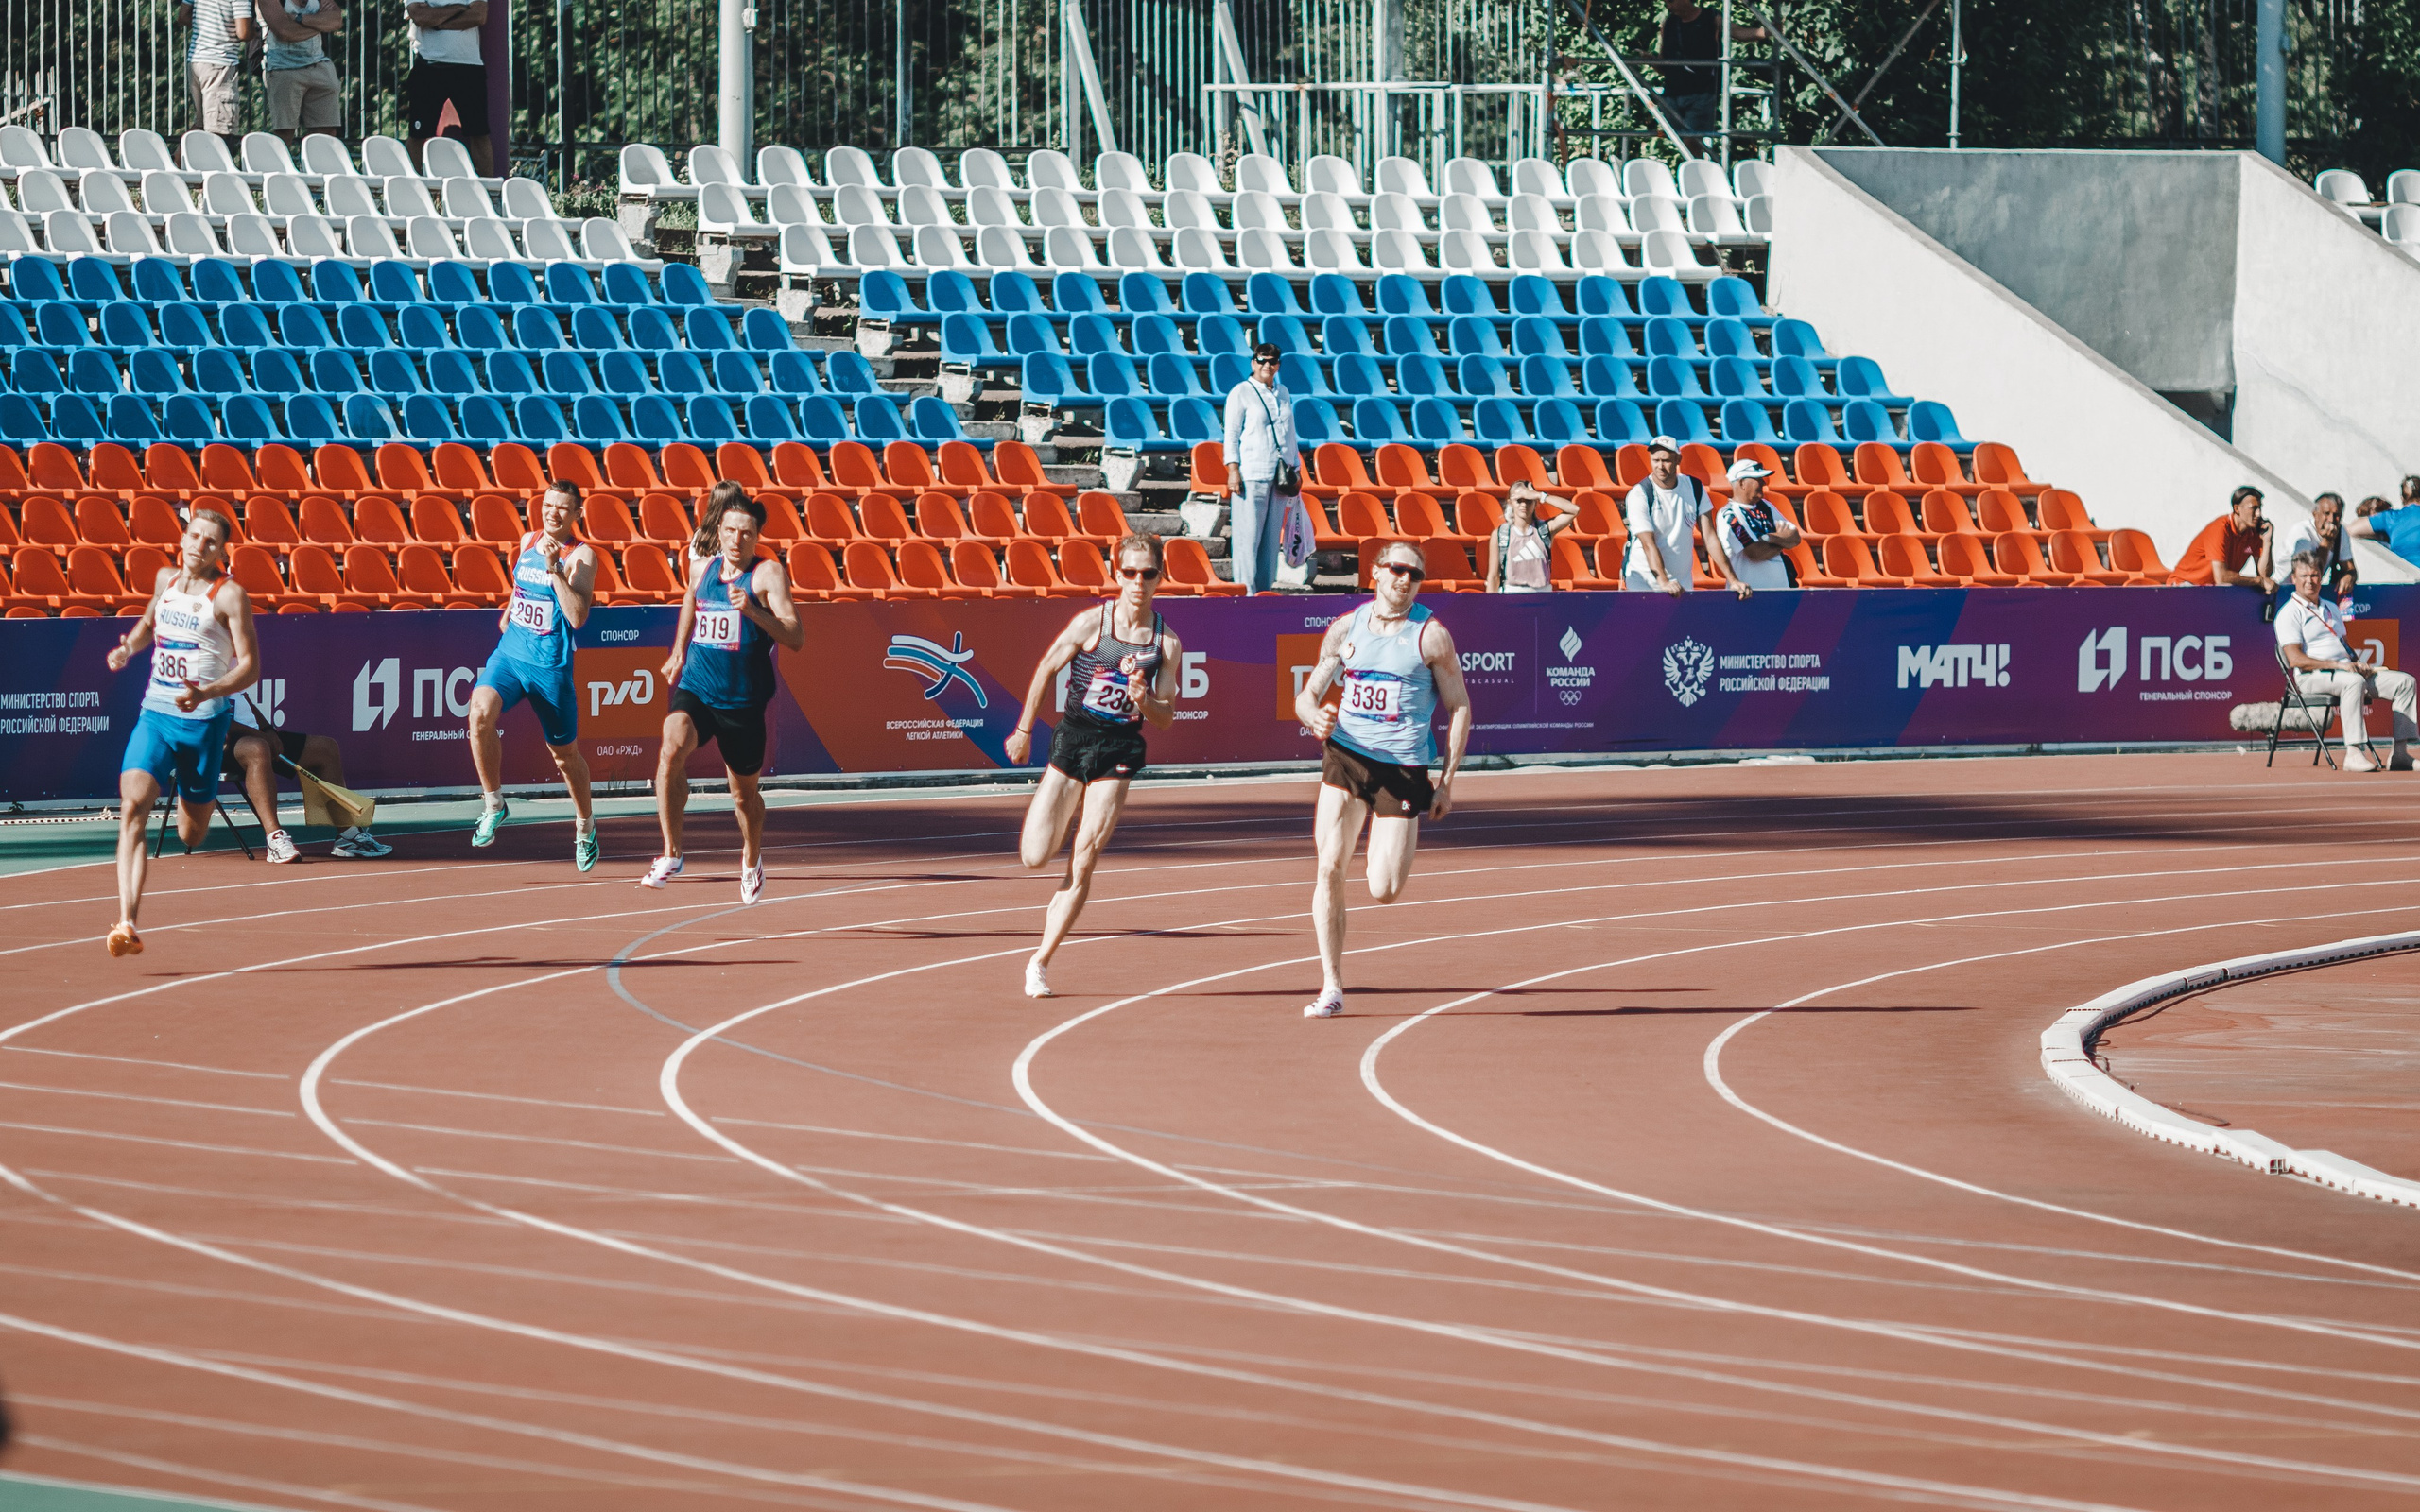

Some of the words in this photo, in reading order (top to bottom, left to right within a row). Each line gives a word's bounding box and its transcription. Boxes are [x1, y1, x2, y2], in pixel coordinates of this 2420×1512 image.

[517, 566, 552, 586] RUSSIA
[160, 609, 199, 631] RUSSIA
[516, 601, 544, 627] 296
[1305, 616, 1338, 627] СПОНС
[601, 630, 640, 642] СПОНСОР
[700, 615, 729, 640] 619
[158, 652, 187, 679] 386
[1720, 655, 1787, 669] МИНИСТЕРСТВО
[1789, 654, 1821, 669] СПОРТА
[1897, 644, 2011, 688] МАТЧ!
[2140, 635, 2233, 681] ПСБ
[1546, 667, 1596, 678] КОМАНДА
[1550, 678, 1590, 687] РОССИИ
[1720, 674, 1776, 692] РОССИЙСКОЙ
[1778, 676, 1830, 693] ФЕДЕРАЦИИ
[0, 693, 66, 710] МИНИСТЕРСТВО
[69, 692, 100, 708] СПОРТА
[413, 666, 486, 718] ПС
[1352, 684, 1387, 711] 539
[2139, 689, 2193, 702] ГЕНЕРАЛЬНЫЙ
[2194, 690, 2233, 700] СПОНСОР
[0, 714, 56, 734] РОССИЙСКОЙ
[59, 715, 109, 735] ФЕДЕРАЦИИ
[886, 718, 944, 730] ВСЕРОССИЙСКАЯ
[946, 718, 984, 729] ФЕДЕРАЦИЯ
[412, 728, 464, 741] ГЕНЕРАЛЬНЫЙ
[906, 730, 930, 741] ЛЕГКОЙ
[932, 730, 963, 740] АТЛЕТИКИ
[596, 745, 614, 756] ОАО
[615, 745, 643, 756] «РЖД»
